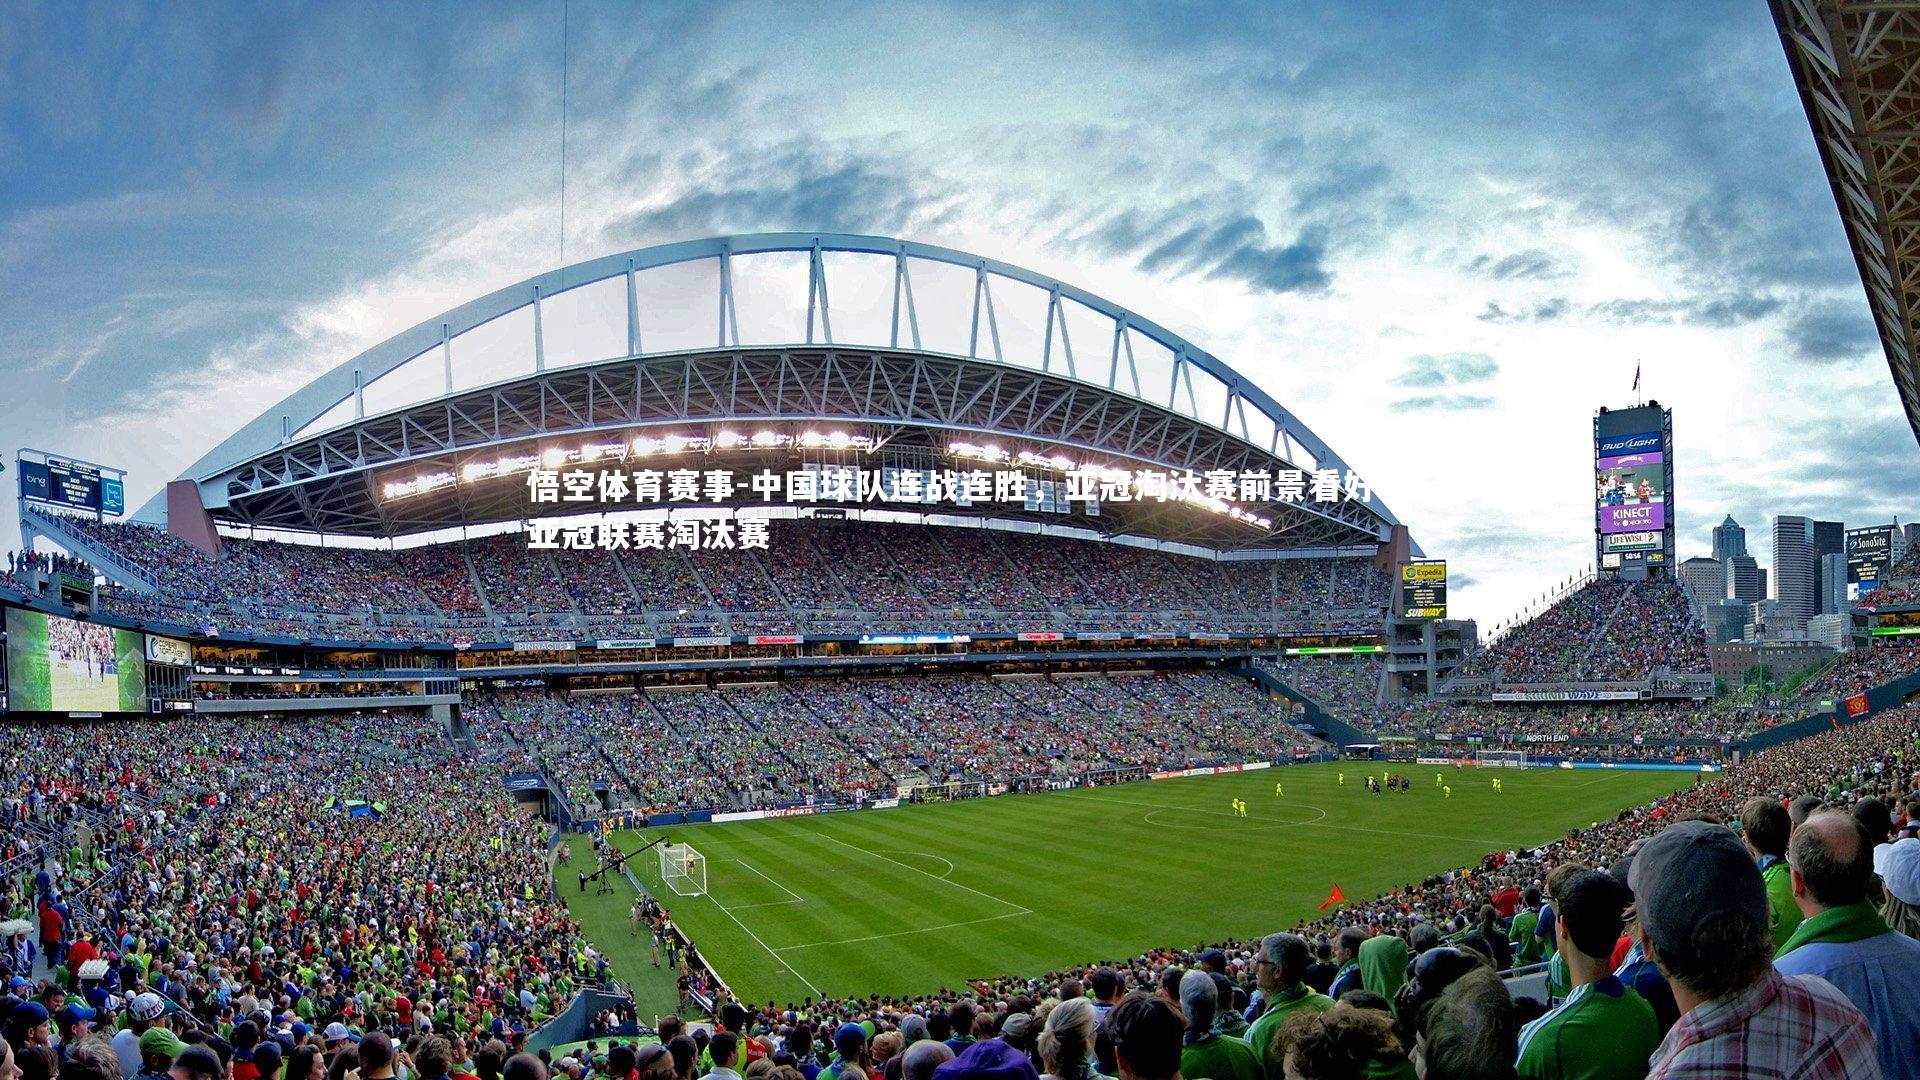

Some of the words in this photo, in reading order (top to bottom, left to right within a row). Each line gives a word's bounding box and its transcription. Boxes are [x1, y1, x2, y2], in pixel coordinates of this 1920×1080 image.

[1628, 439, 1658, 447] LIGHT
[26, 475, 46, 487] bing
[1613, 507, 1652, 519] KINECT
[1858, 535, 1886, 548] SonoSite
[1417, 569, 1442, 577] Expedia
[1405, 608, 1445, 617] SUBWAY
[1526, 734, 1552, 742] NORTH
[1553, 734, 1569, 742] END
[764, 809, 786, 817] ROOT
